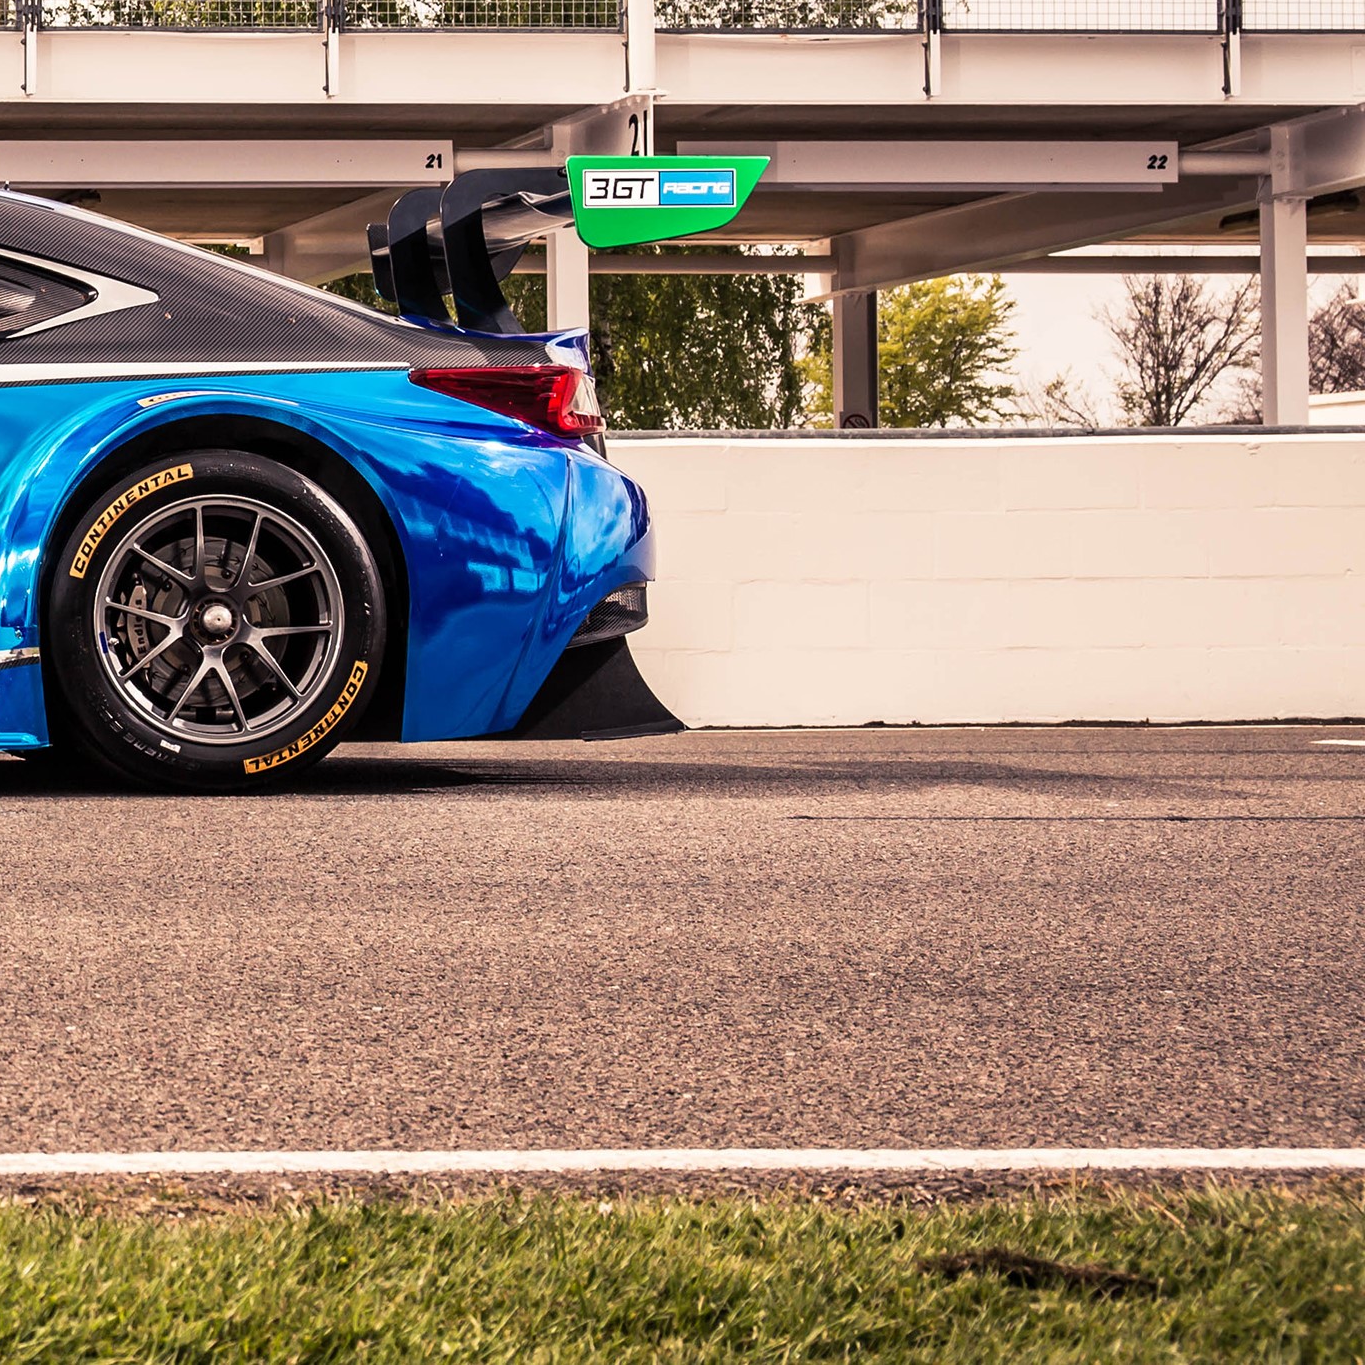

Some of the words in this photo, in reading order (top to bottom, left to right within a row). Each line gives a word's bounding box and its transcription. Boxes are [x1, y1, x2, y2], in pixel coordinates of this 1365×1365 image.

[628, 109, 648, 156] 21
[425, 153, 442, 169] 21
[1146, 154, 1169, 170] 22
[589, 178, 655, 200] 3GT
[74, 466, 190, 575] CONTINENTAL
[247, 665, 366, 771] CONTINENTAL
